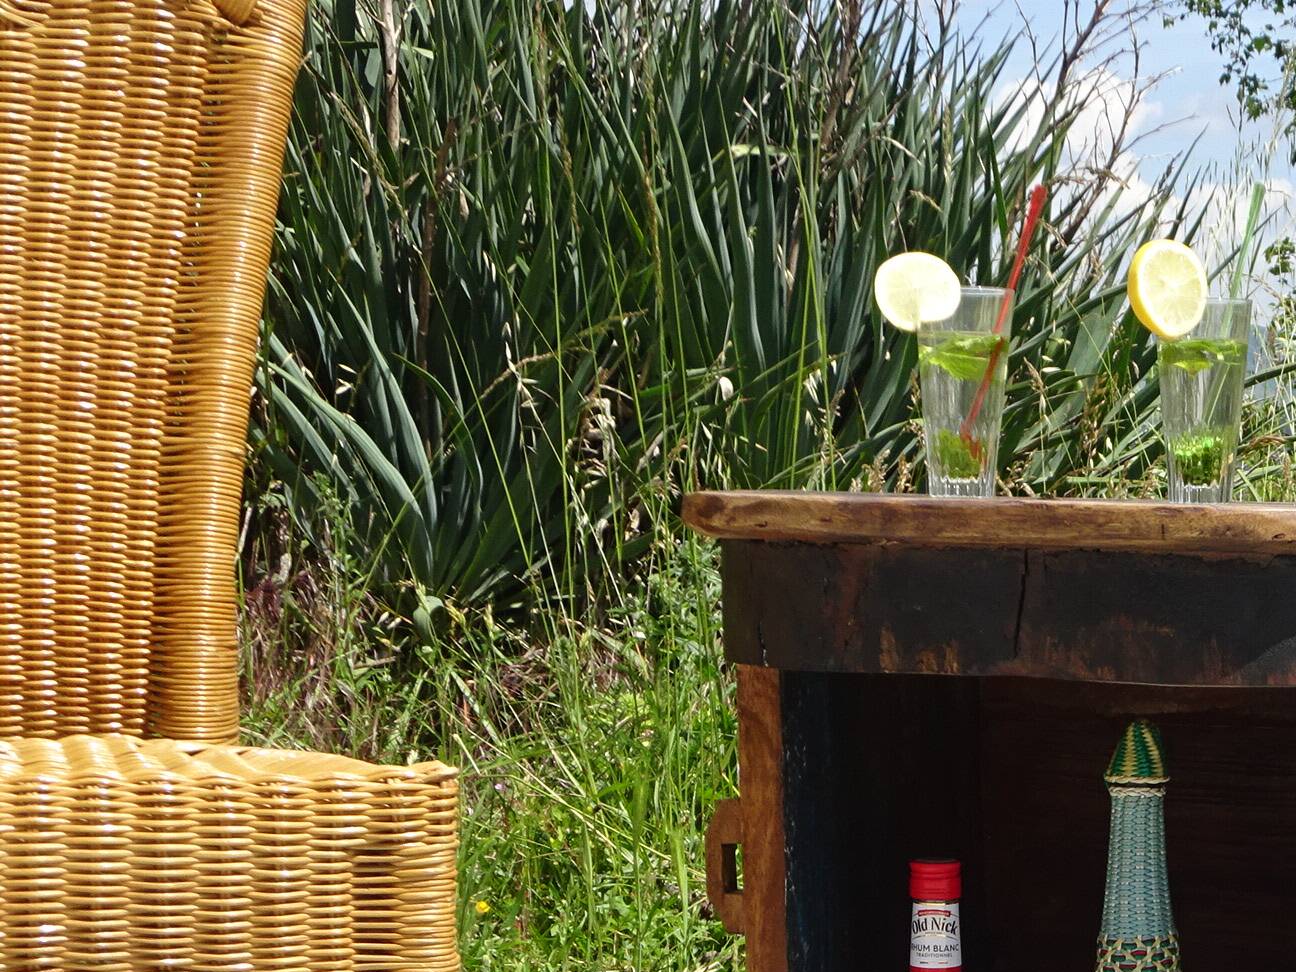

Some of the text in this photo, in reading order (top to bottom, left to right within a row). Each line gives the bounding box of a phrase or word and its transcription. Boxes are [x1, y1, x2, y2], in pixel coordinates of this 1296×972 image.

[912, 916, 958, 935] Old Nick
[933, 943, 959, 952] BLANC
